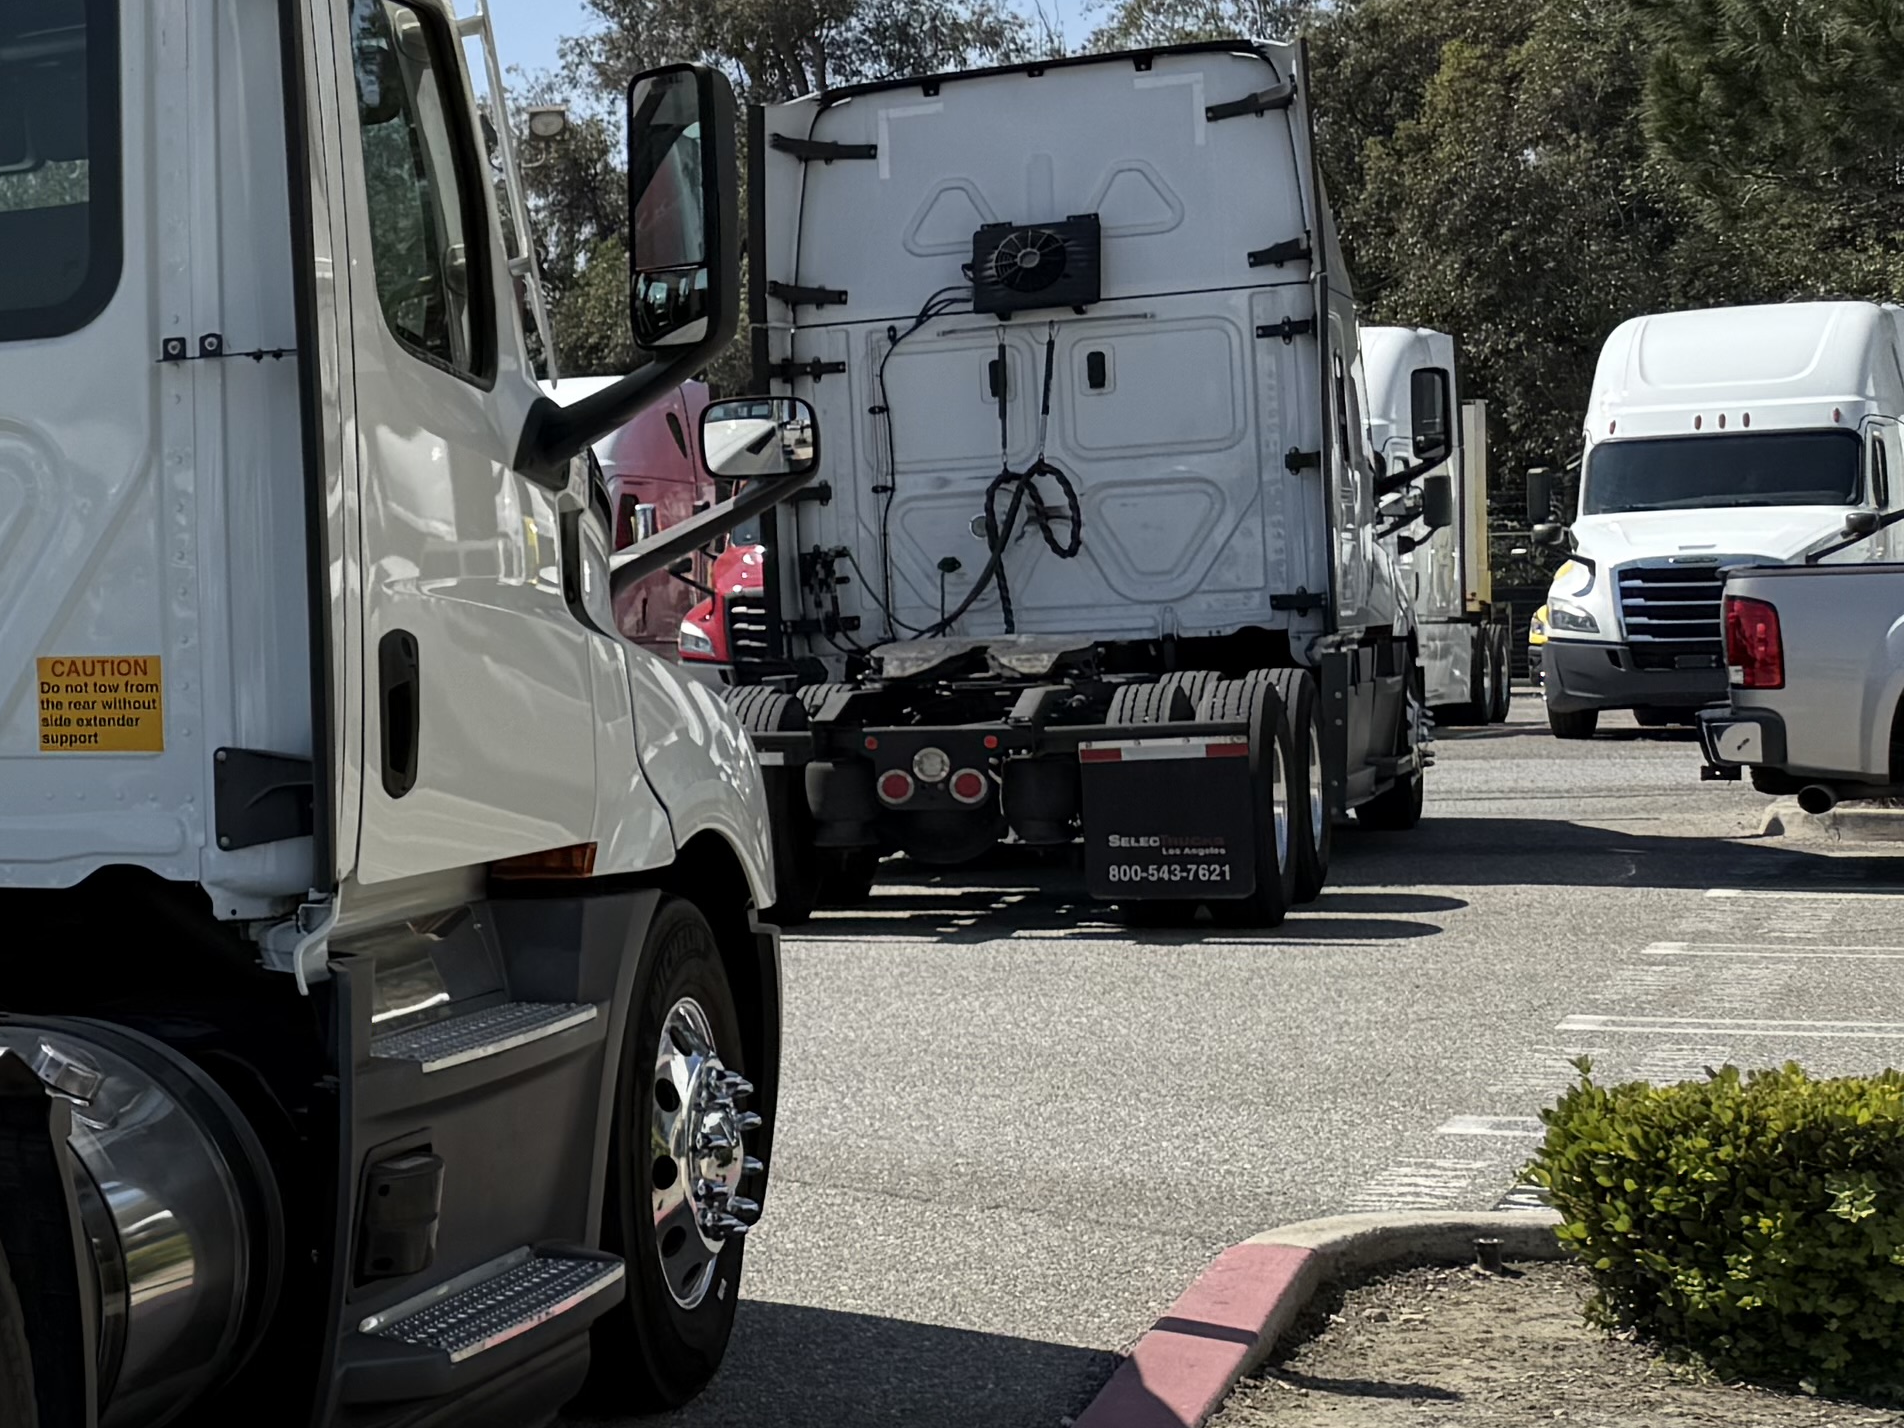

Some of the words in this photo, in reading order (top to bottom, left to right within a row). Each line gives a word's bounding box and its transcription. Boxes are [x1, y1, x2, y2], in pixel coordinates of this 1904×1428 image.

[51, 659, 148, 677] CAUTION
[40, 681, 60, 694] Do
[65, 681, 89, 693] not
[93, 681, 120, 693] tow
[124, 680, 159, 693] from
[40, 698, 63, 710] the
[68, 699, 97, 710] rear
[101, 697, 157, 710] without
[41, 714, 71, 727] side
[76, 714, 140, 727] extender
[41, 732, 99, 747] support
[1162, 847, 1180, 855] Los
[1183, 847, 1226, 856] Angeles
[1109, 864, 1230, 882] 800-543-7621
